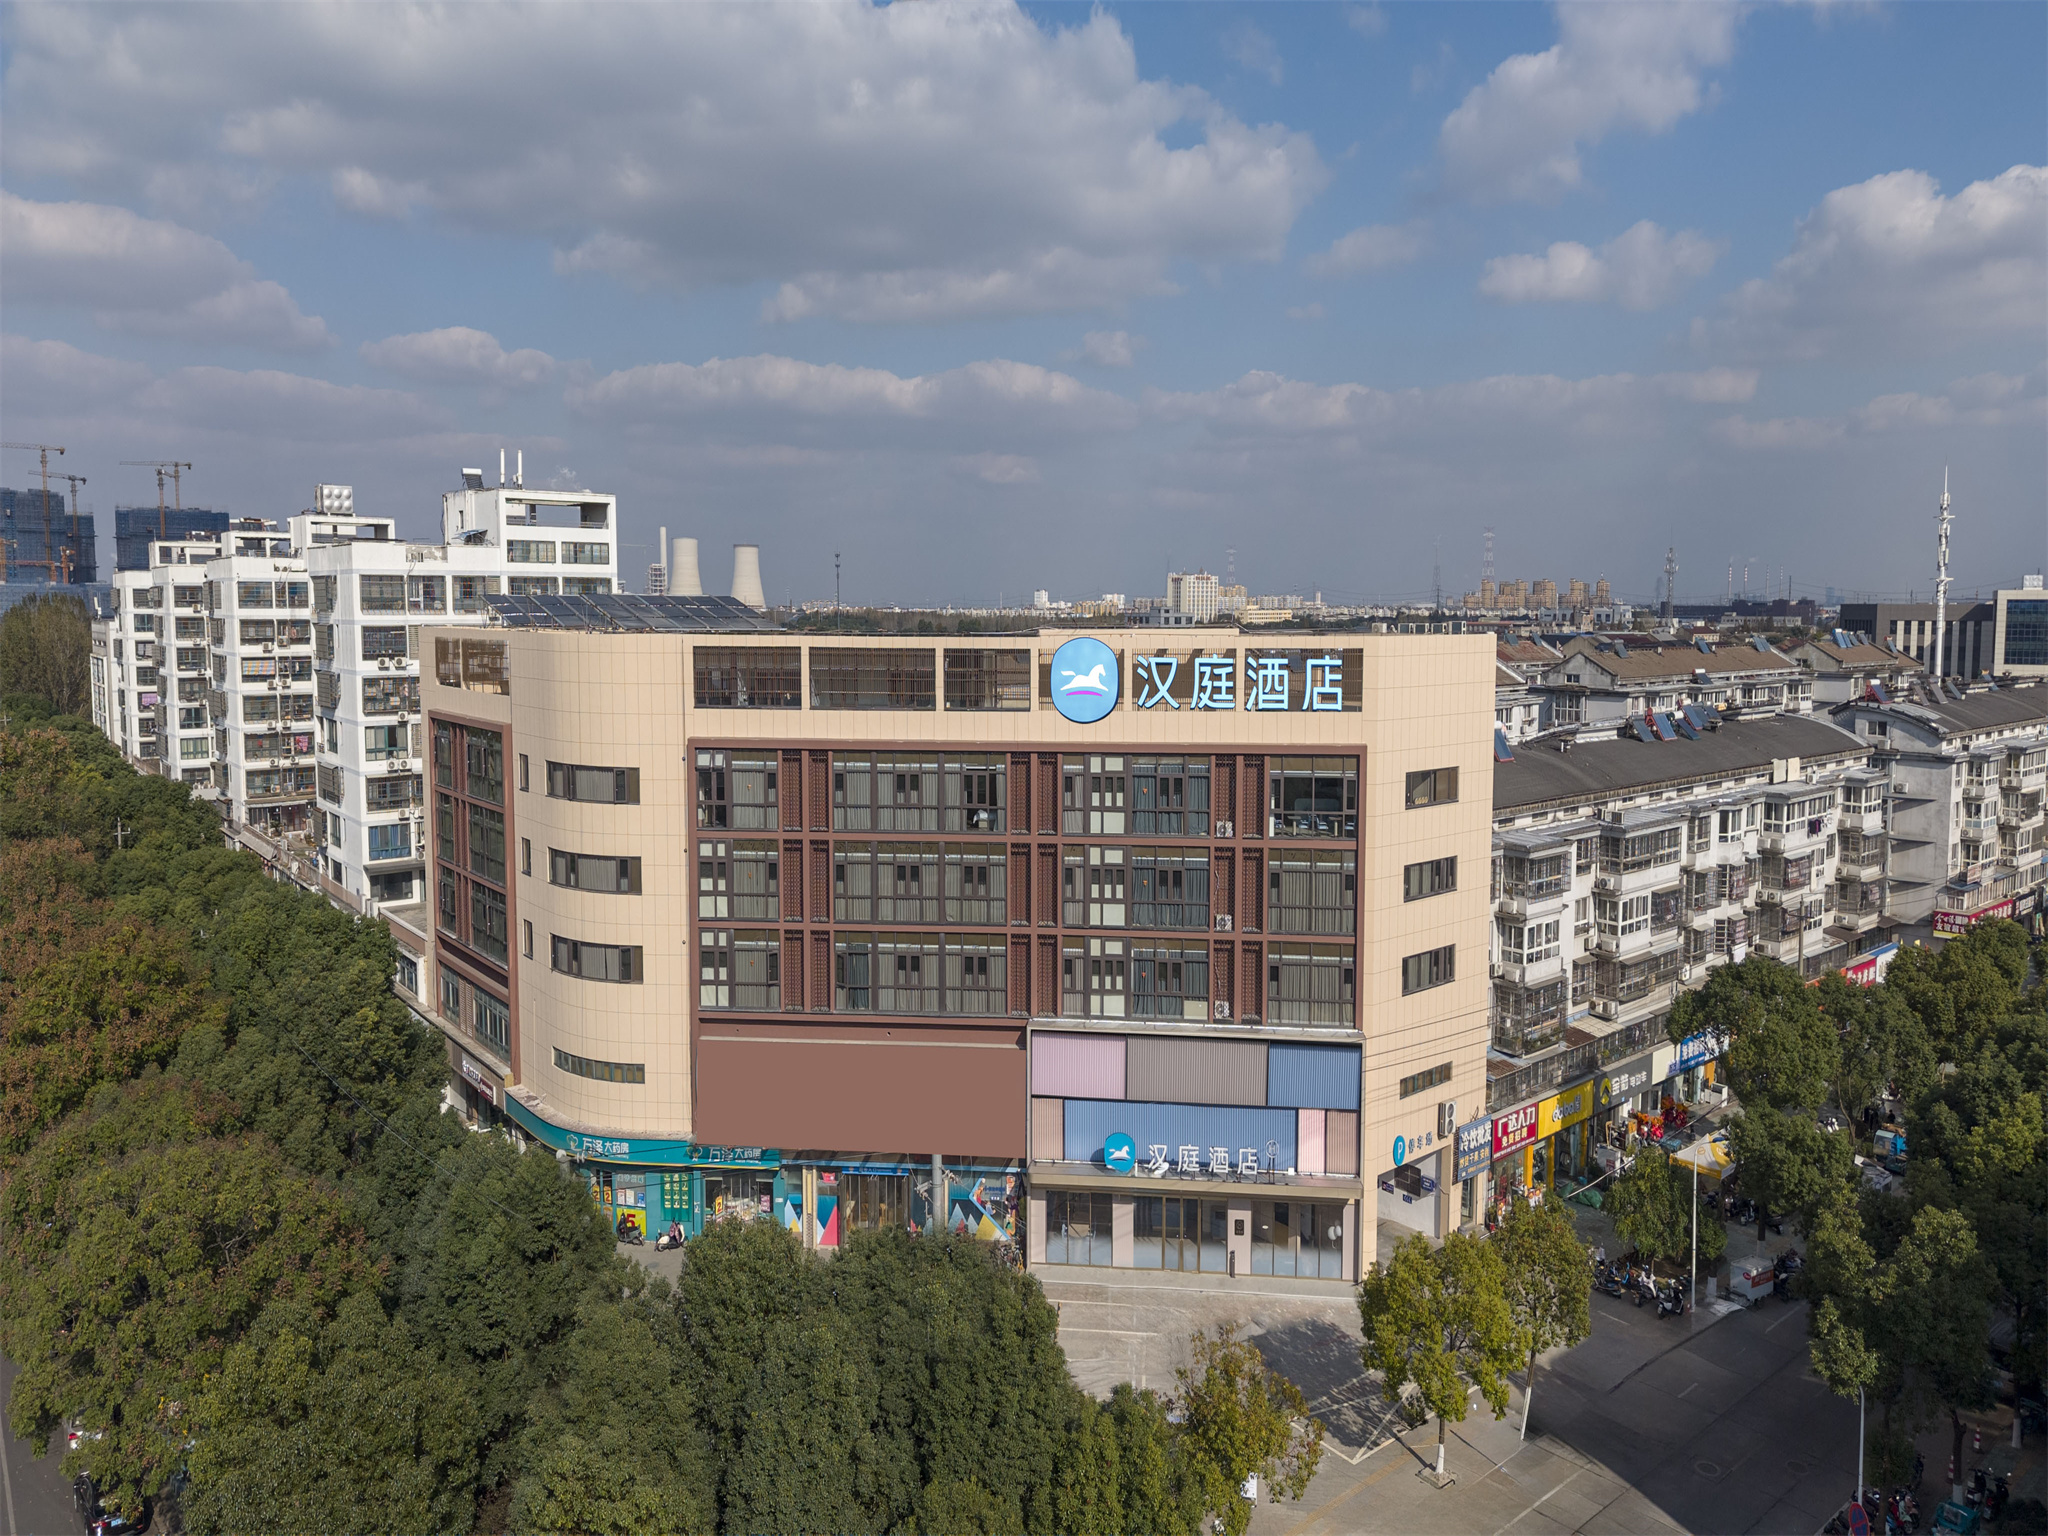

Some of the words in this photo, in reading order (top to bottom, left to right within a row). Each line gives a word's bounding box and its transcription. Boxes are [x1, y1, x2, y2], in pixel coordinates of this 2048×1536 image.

[1136, 653, 1344, 712] 汉庭酒店
[1497, 1106, 1536, 1138] 广达人力
[582, 1137, 630, 1155] 万泽大药房
[1460, 1120, 1492, 1152] 冷饮批发
[1501, 1127, 1528, 1148] 免费招聘
[708, 1146, 762, 1162] 万泽大药房
[1148, 1144, 1258, 1175] 汉庭酒店
[626, 1213, 636, 1227] 5
